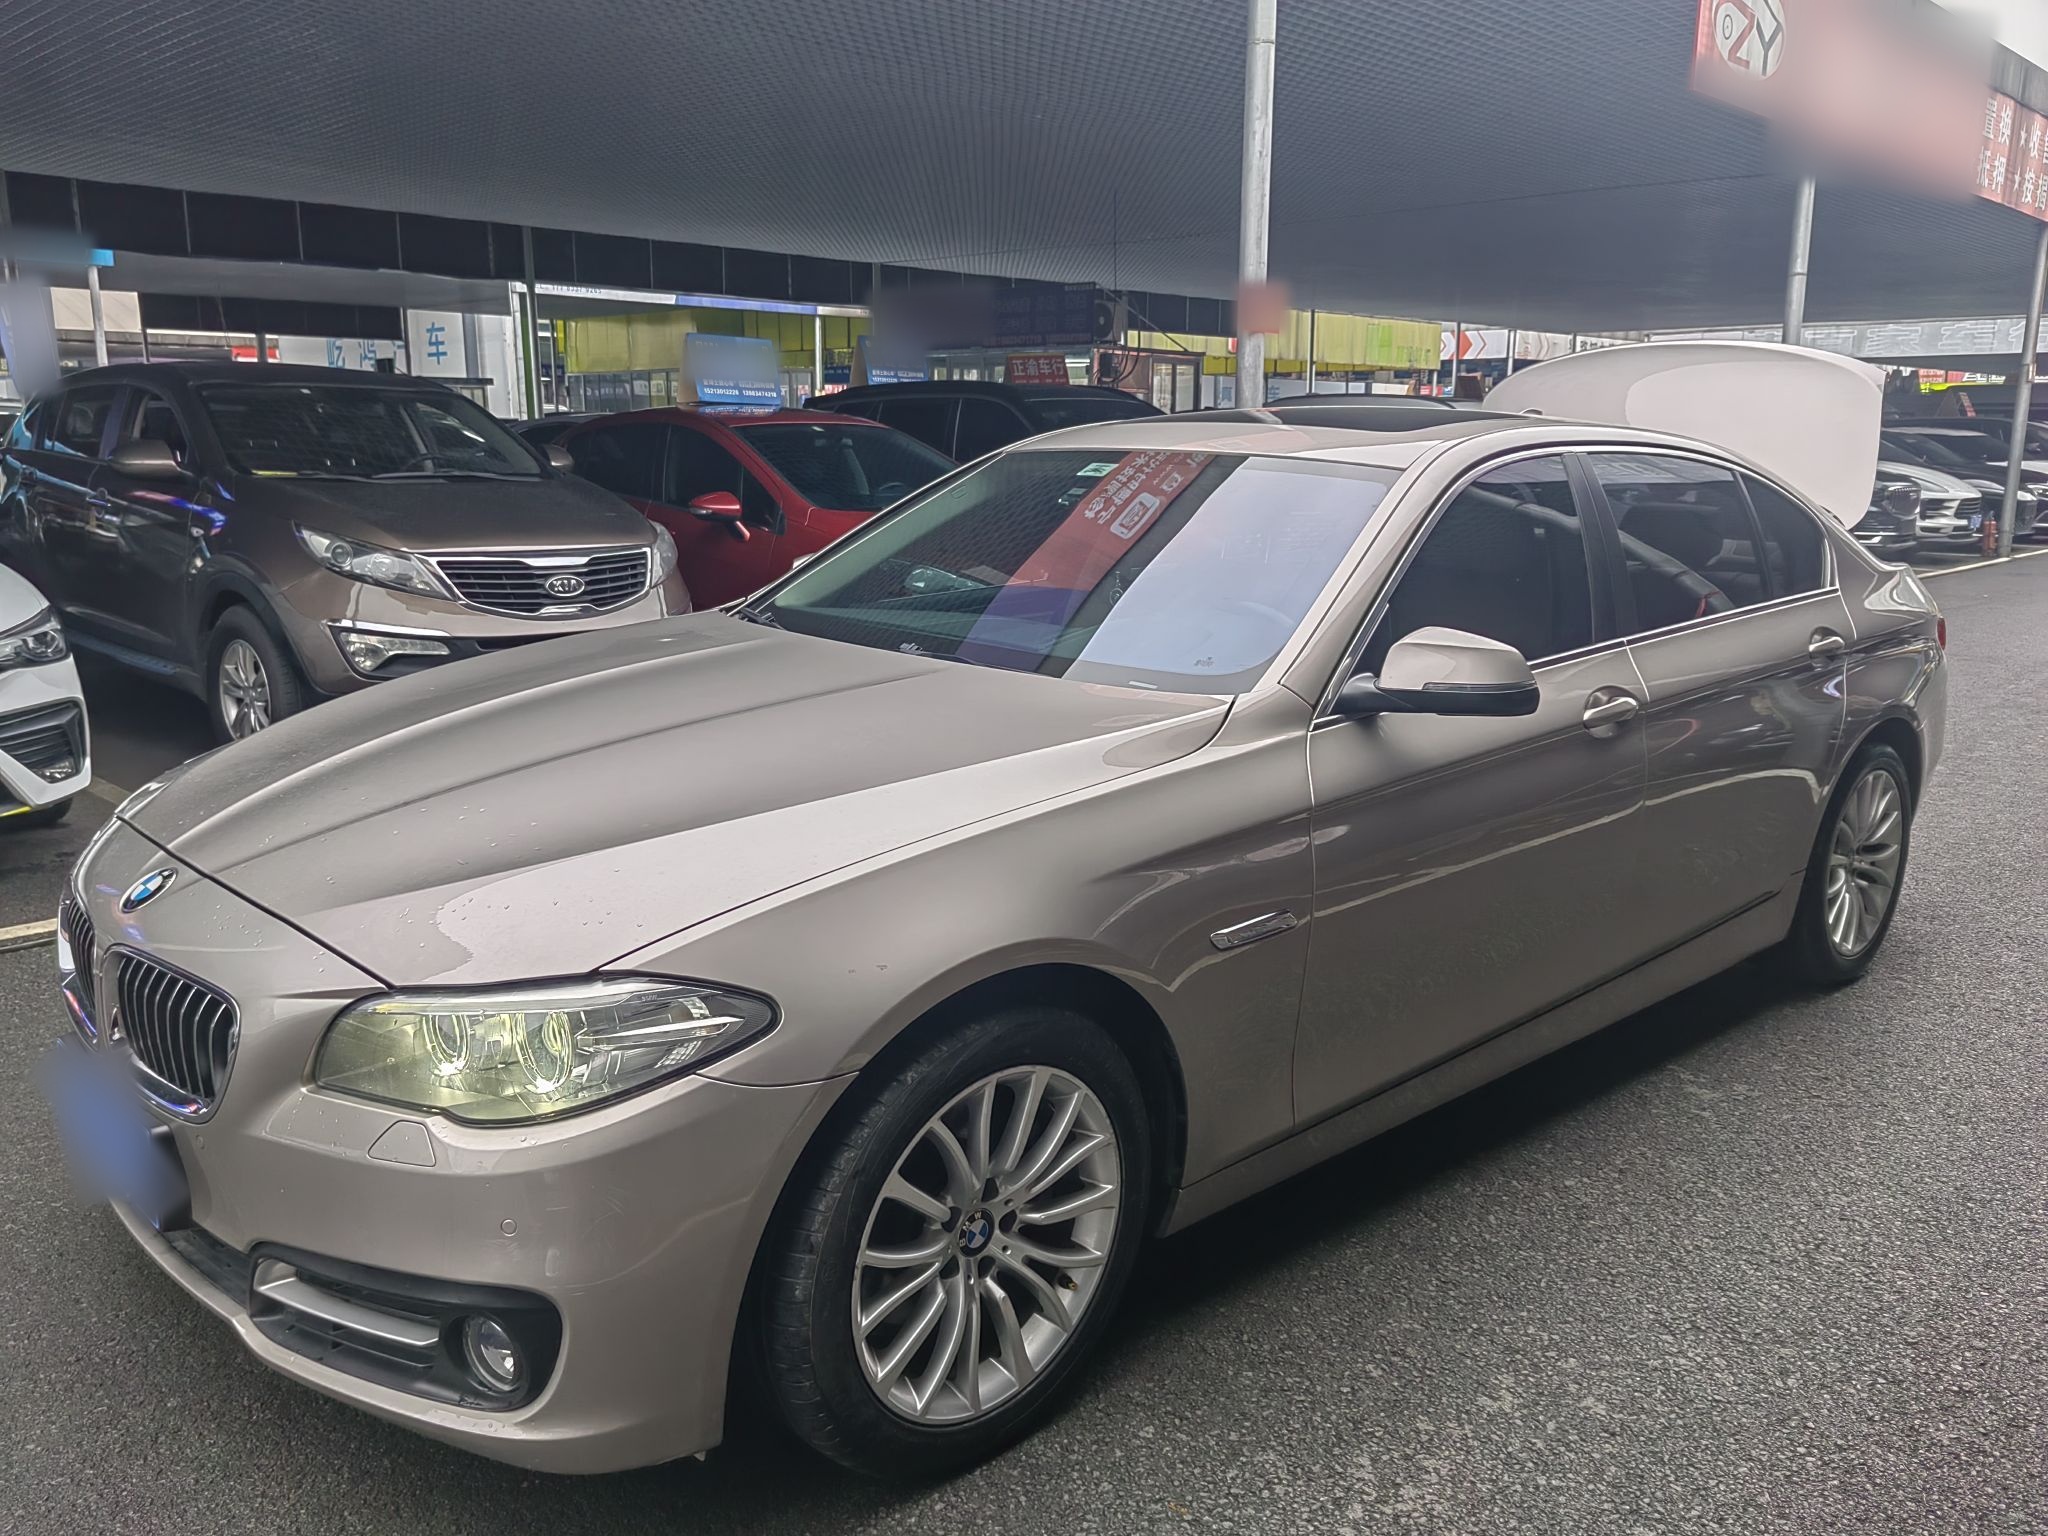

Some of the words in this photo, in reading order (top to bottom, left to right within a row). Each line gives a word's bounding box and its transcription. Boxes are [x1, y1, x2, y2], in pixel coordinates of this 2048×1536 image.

[1012, 358, 1065, 377] 正渝车行
[553, 579, 580, 592] KIA
